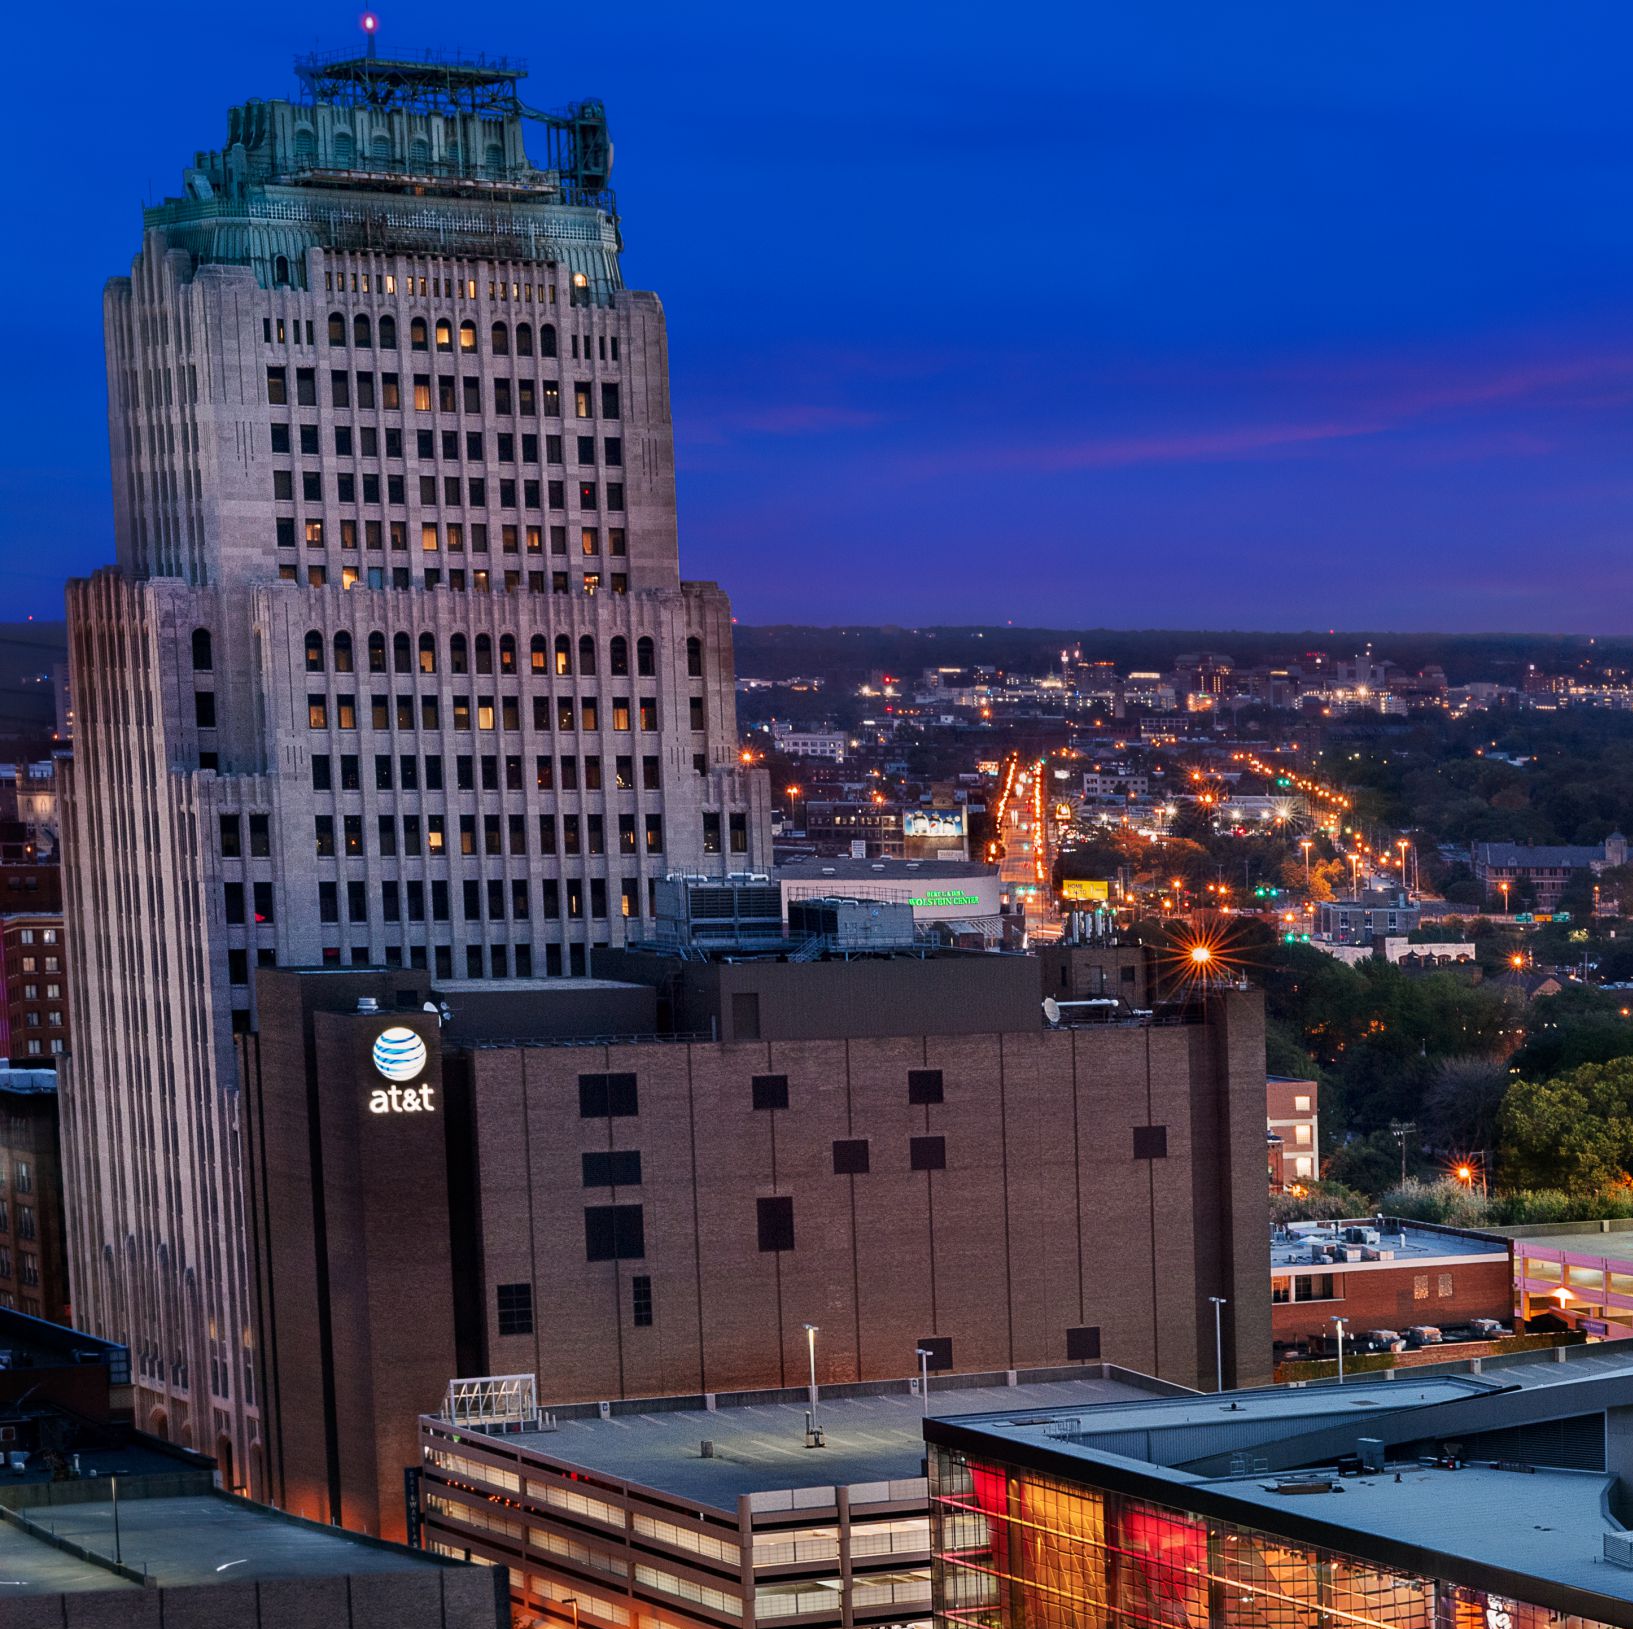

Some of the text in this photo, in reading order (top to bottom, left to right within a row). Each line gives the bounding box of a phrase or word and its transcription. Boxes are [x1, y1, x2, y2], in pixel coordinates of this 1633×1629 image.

[908, 896, 980, 906] WOLSTEIN CENTER
[368, 1083, 435, 1113] at&t
